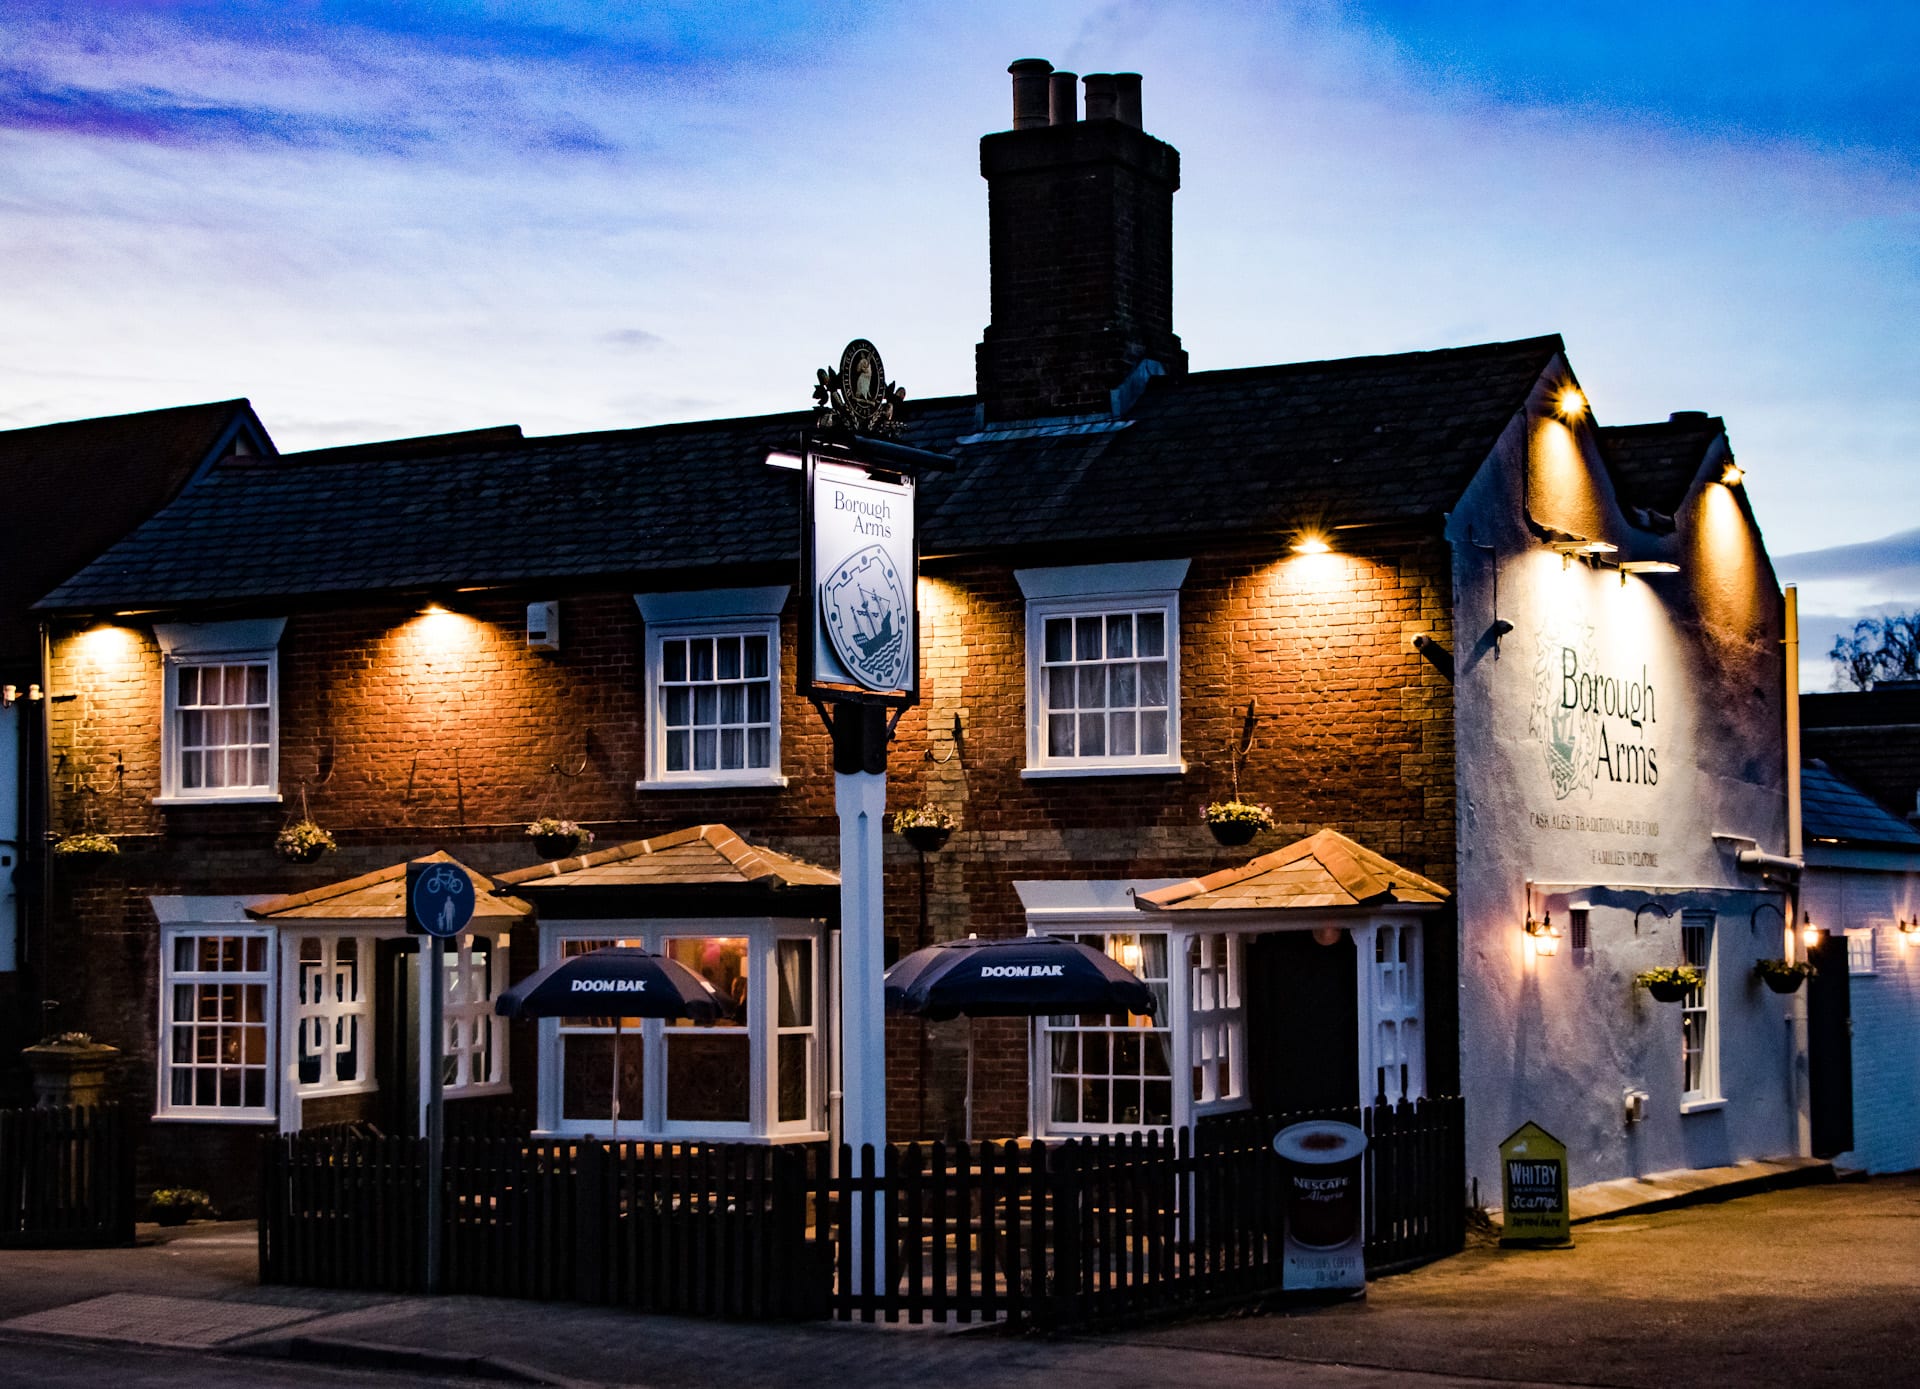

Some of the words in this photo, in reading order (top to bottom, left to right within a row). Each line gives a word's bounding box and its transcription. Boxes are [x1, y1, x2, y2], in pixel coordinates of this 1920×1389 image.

[834, 490, 891, 522] Borough
[853, 515, 892, 538] Arms
[1561, 647, 1656, 738] Borough
[1595, 720, 1658, 786] Arms
[1530, 812, 1549, 829] CASK
[1552, 814, 1570, 830] ALES
[1576, 815, 1625, 834] TRADITIONAL
[1626, 820, 1640, 835] PUB
[981, 965, 1029, 978] DOOM
[1031, 965, 1063, 976] BAR
[571, 980, 615, 992] DOOM
[617, 980, 646, 992] BAR
[1509, 1162, 1557, 1185] WHITBY
